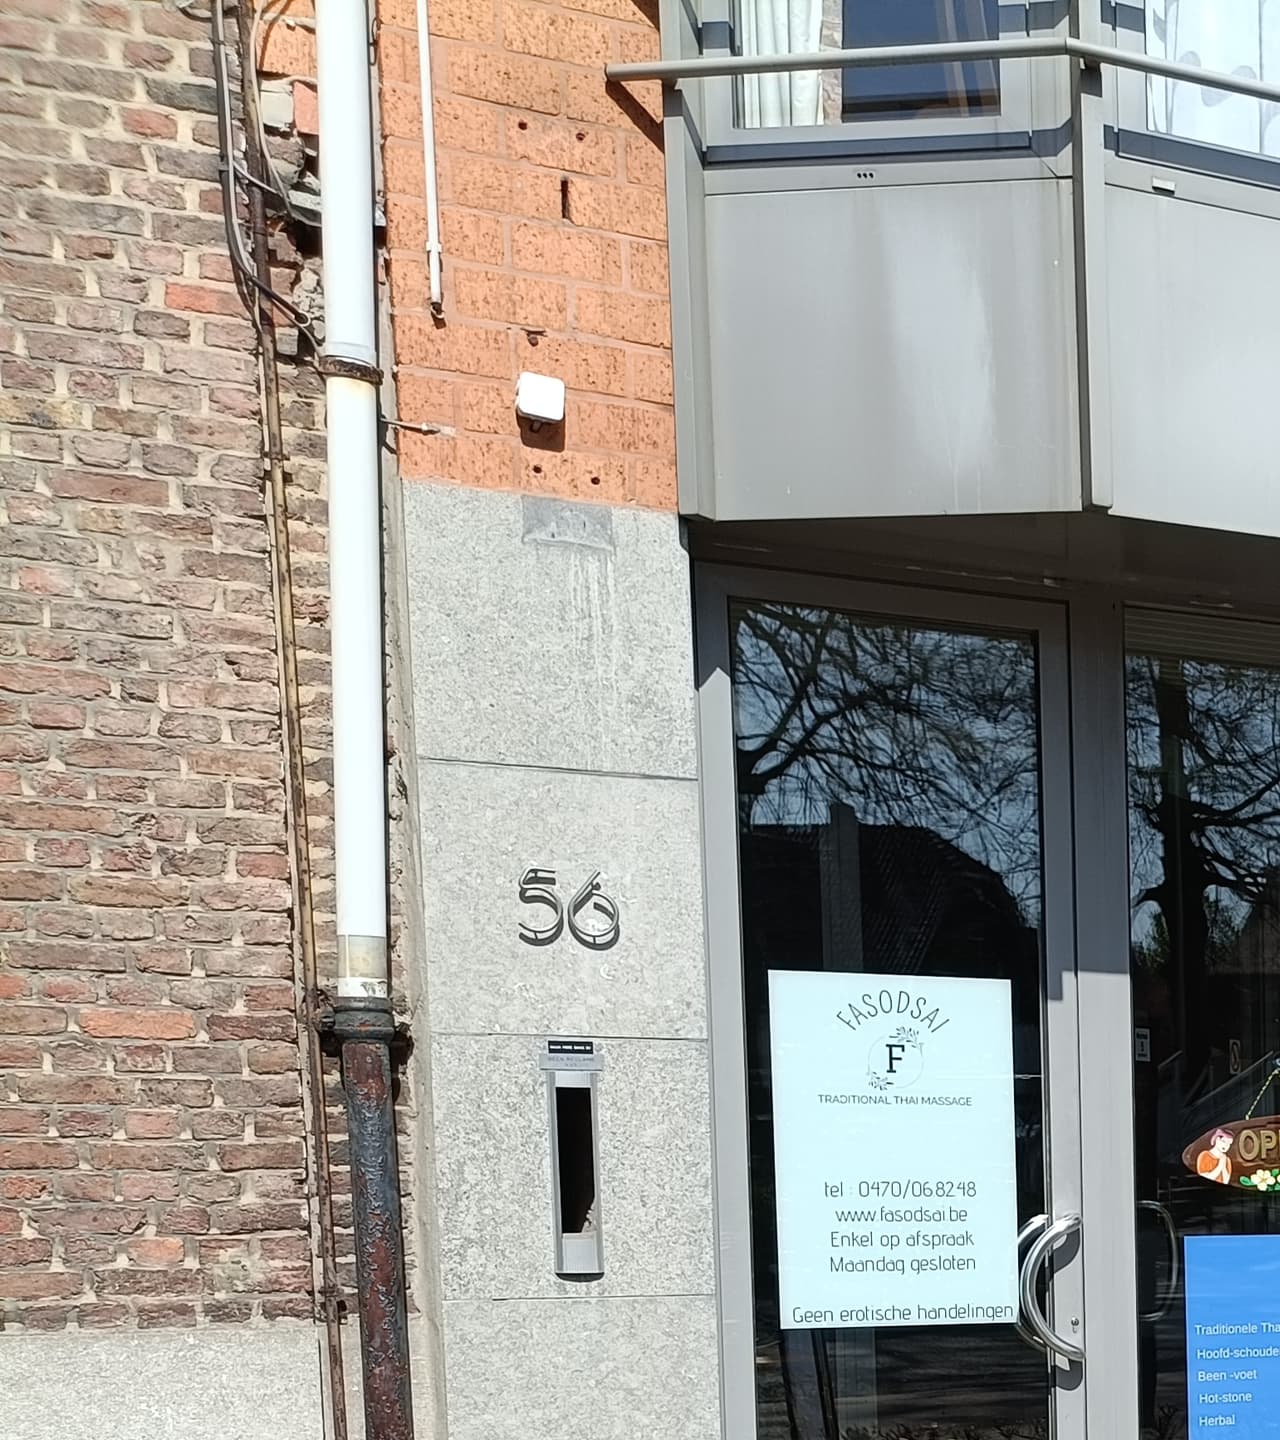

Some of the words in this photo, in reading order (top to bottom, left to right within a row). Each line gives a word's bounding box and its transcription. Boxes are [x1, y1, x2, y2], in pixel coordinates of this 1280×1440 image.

[518, 866, 620, 949] 56
[836, 989, 950, 1033] FASODSAI
[885, 1043, 905, 1073] F
[818, 1094, 891, 1105] TRADITIONAL
[894, 1095, 918, 1105] THAI
[921, 1096, 973, 1107] MASSAGE
[824, 1181, 843, 1198] tel
[835, 1205, 968, 1222] www.fasodsai.be
[831, 1231, 873, 1247] Enkel
[880, 1235, 900, 1250] op
[906, 1231, 975, 1250] afspraak
[830, 1256, 905, 1275] Maandag
[910, 1255, 976, 1275] gesloten
[792, 1306, 834, 1323] Geen
[840, 1305, 911, 1322] erotische
[917, 1303, 1014, 1321] handelingen
[1194, 1322, 1258, 1336] Traditionele
[1198, 1371, 1227, 1382] Been
[1199, 1391, 1252, 1404] Hot-stone
[1199, 1414, 1236, 1427] Herbal
